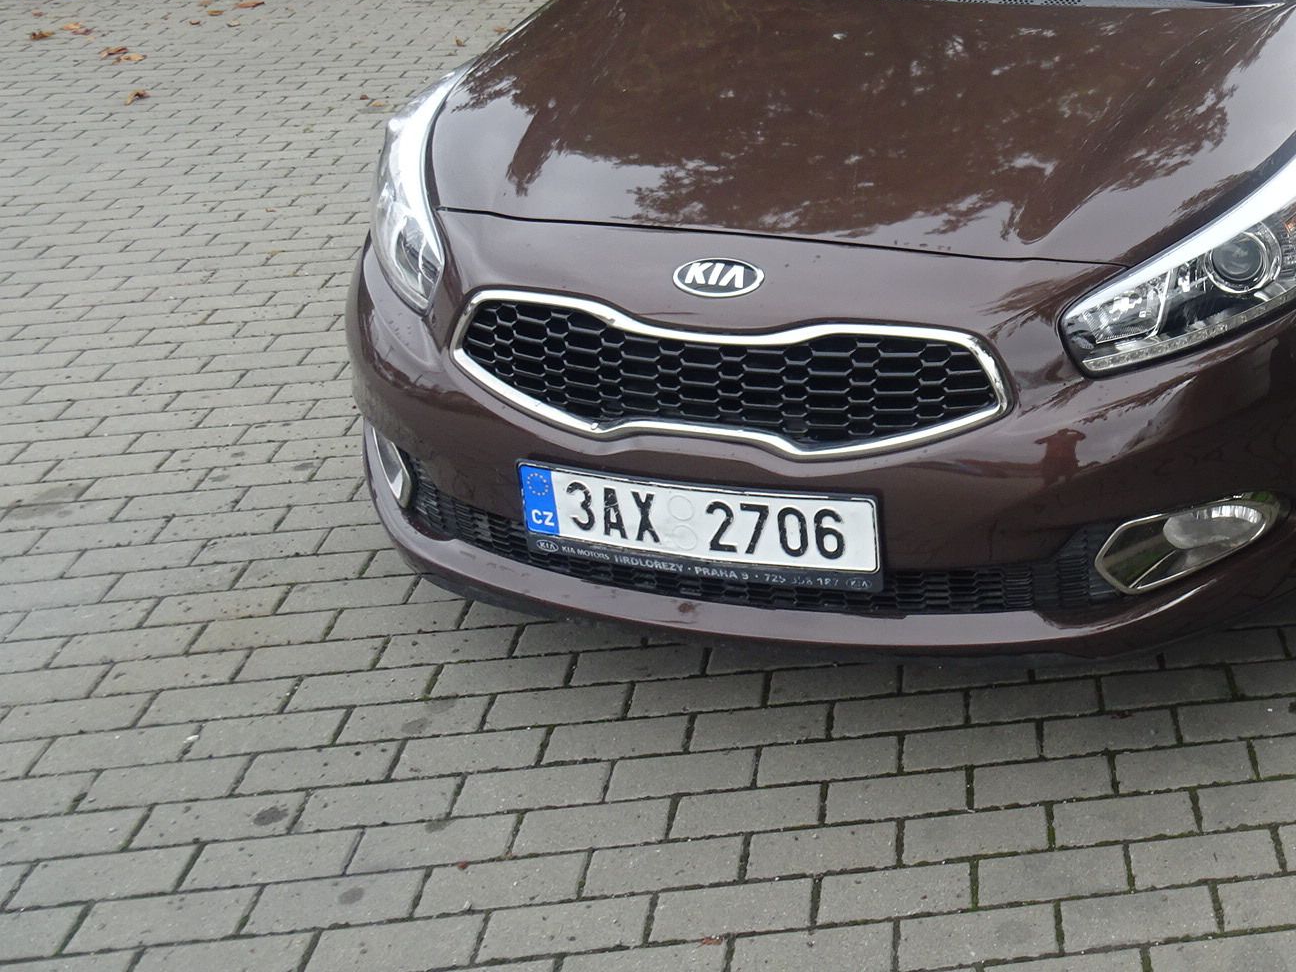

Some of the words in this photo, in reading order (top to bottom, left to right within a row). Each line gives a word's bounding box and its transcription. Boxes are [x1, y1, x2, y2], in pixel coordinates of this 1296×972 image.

[684, 260, 745, 289] KIA
[531, 508, 555, 527] CZ
[565, 480, 660, 544] 3AX
[705, 500, 846, 561] 2706
[561, 545, 576, 554] KIA
